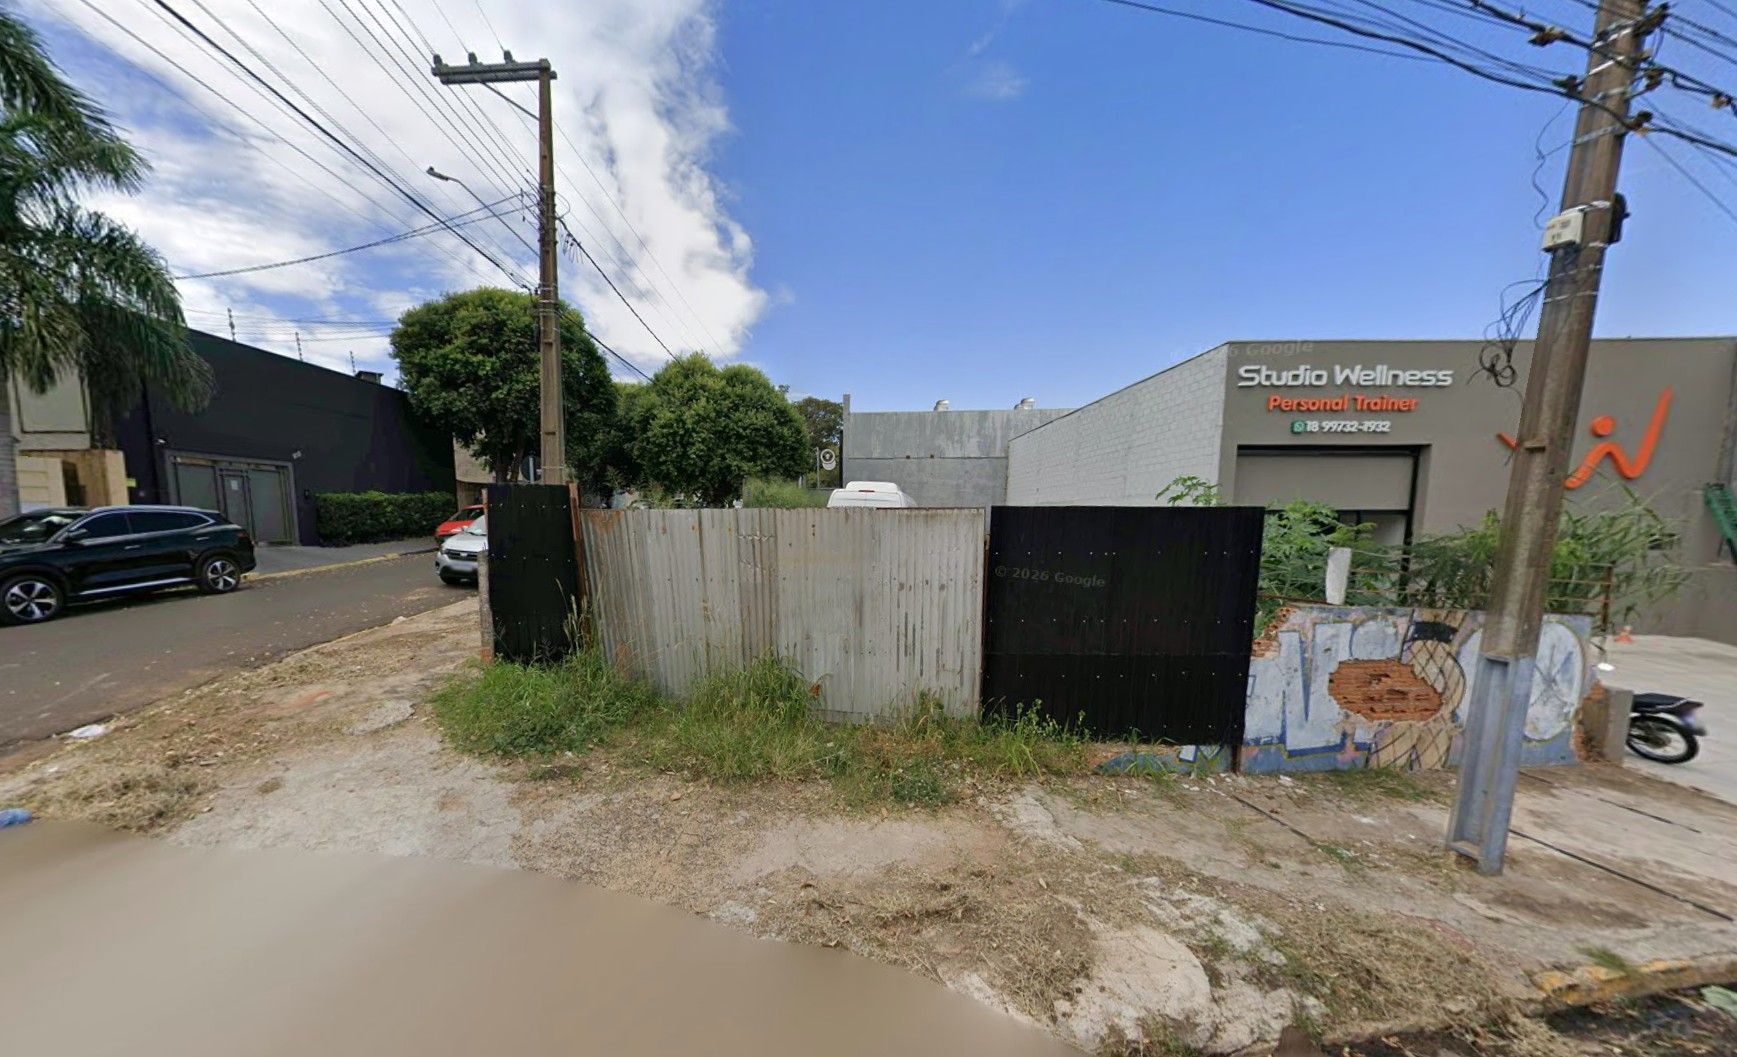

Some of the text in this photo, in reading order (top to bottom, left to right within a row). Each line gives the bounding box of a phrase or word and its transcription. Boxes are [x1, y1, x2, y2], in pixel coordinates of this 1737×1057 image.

[1238, 365, 1454, 386] Studio Wellness
[1267, 394, 1418, 411] Personal Trainer
[1306, 421, 1391, 432] 18 99732-1932
